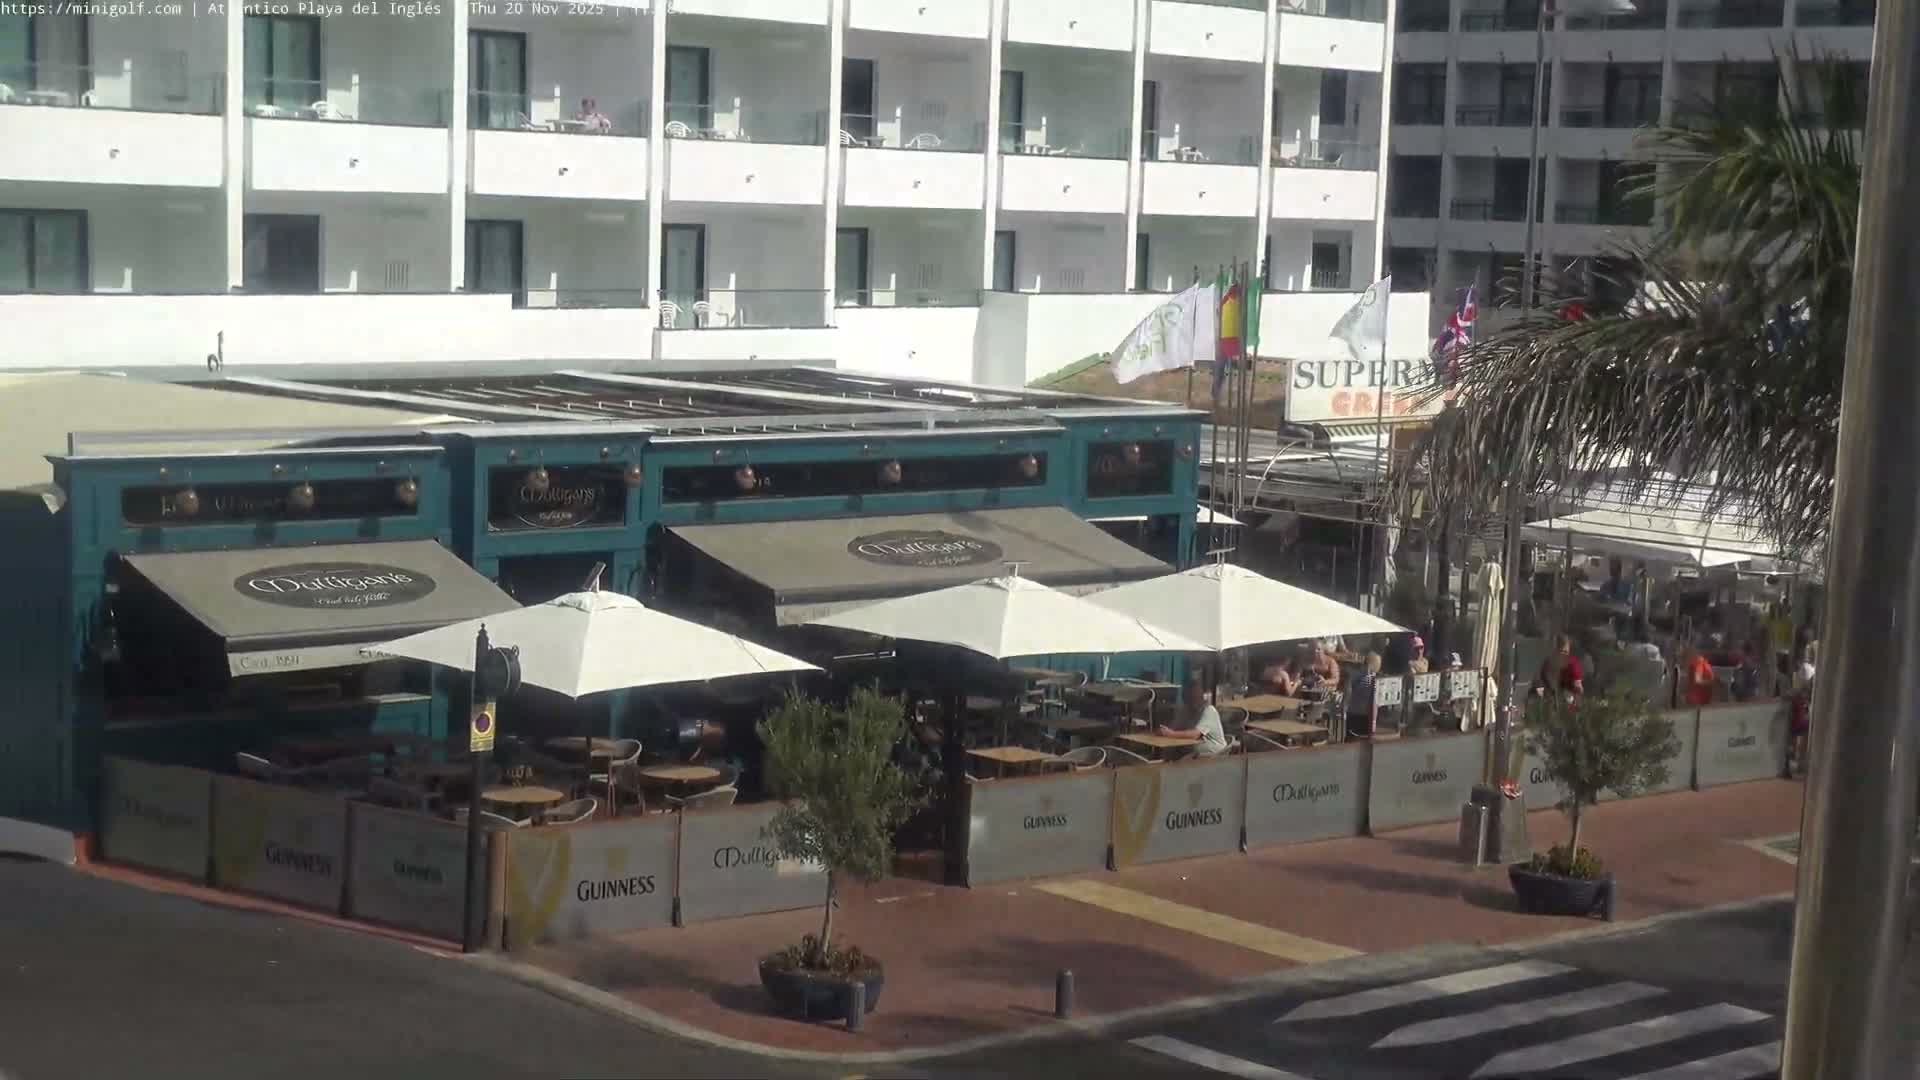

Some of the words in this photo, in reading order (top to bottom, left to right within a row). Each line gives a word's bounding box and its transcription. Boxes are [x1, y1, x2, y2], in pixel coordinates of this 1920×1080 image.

[248, 572, 413, 593] Mulligan's
[1023, 813, 1068, 831] GUINNESS
[1165, 808, 1223, 831] GUINNESS
[576, 875, 656, 903] GUINNESS
